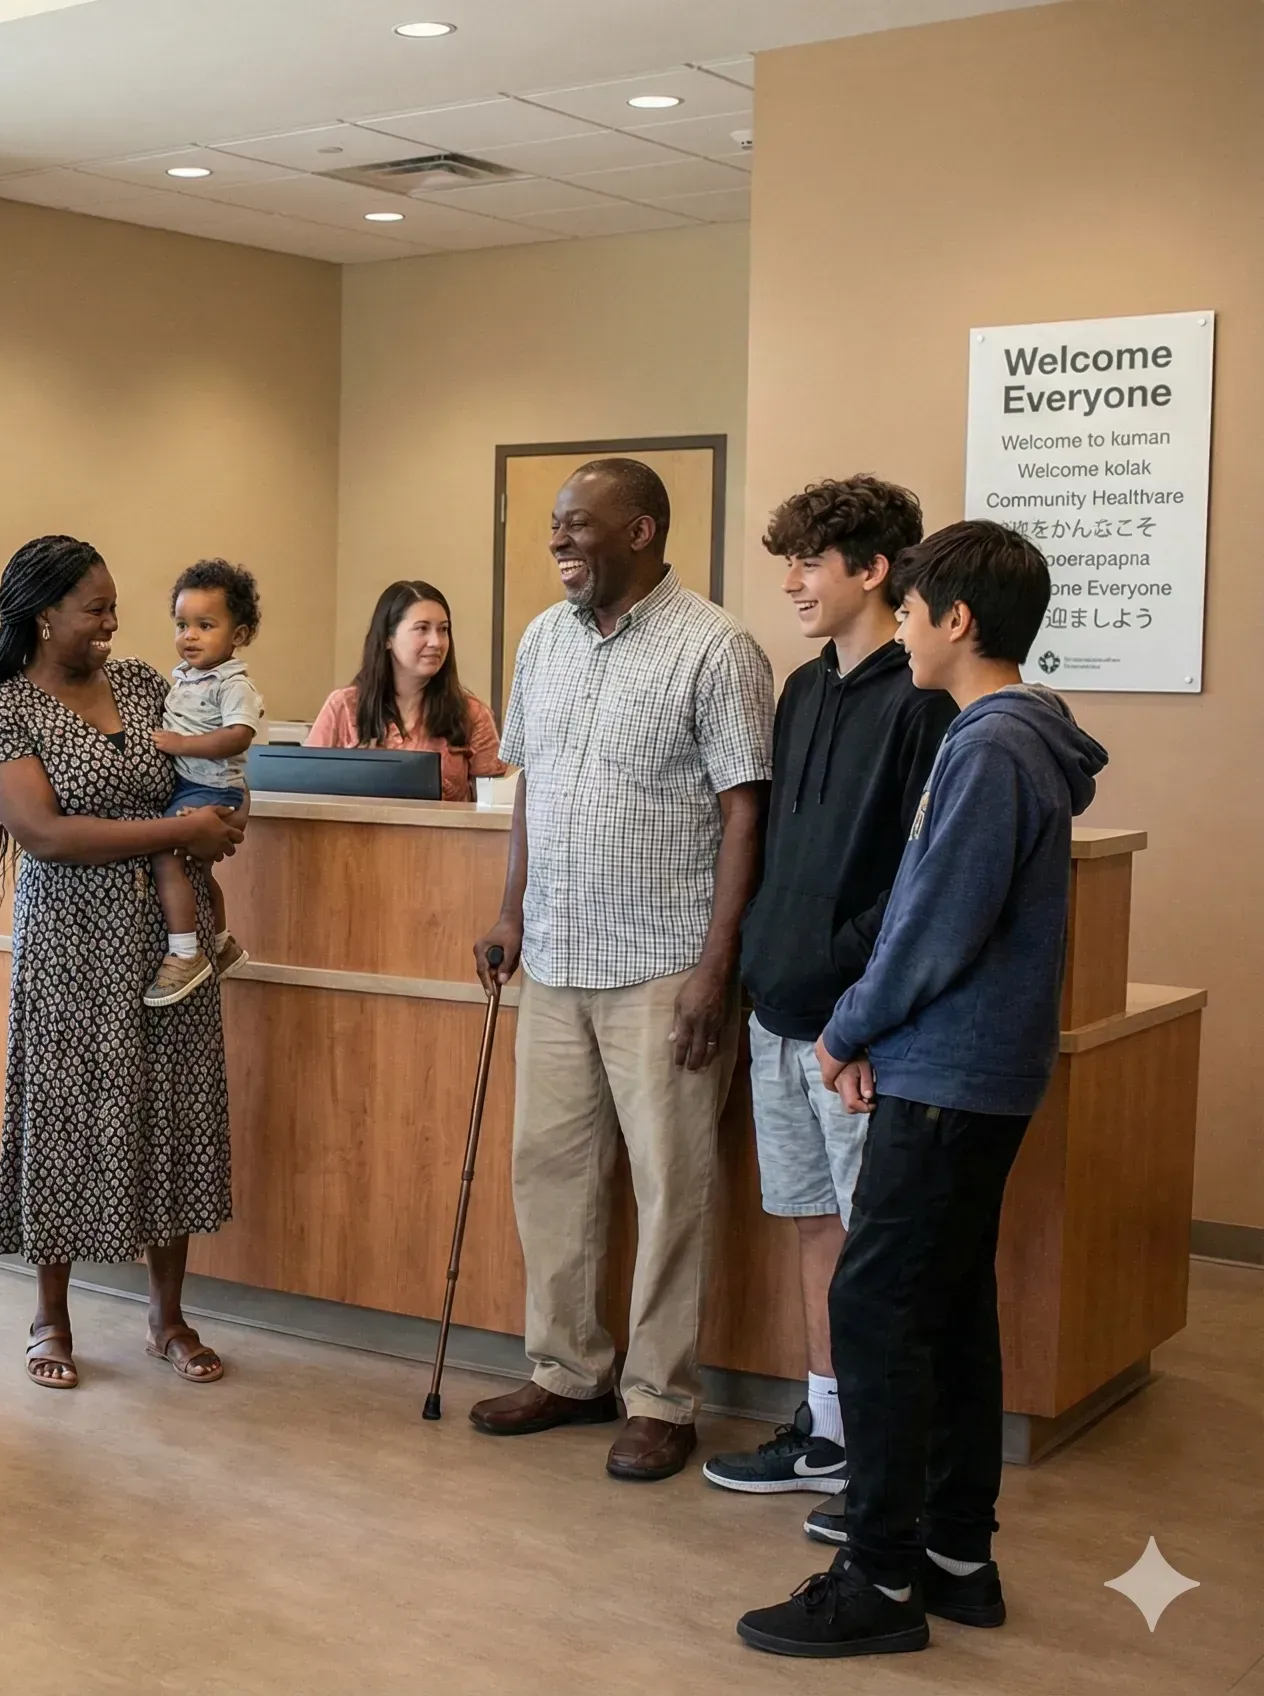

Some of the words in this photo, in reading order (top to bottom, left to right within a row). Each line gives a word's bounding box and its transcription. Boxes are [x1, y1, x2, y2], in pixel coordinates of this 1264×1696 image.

[1004, 345, 1172, 376] Welcome
[1004, 384, 1172, 416] Everyone
[1002, 435, 1082, 450] Welcome
[1088, 434, 1105, 447] to
[1112, 431, 1170, 446] kuman
[1018, 463, 1098, 478] Welcome
[1105, 460, 1151, 476] kolak
[987, 491, 1086, 510] Community
[1088, 580, 1172, 599] Everyone
